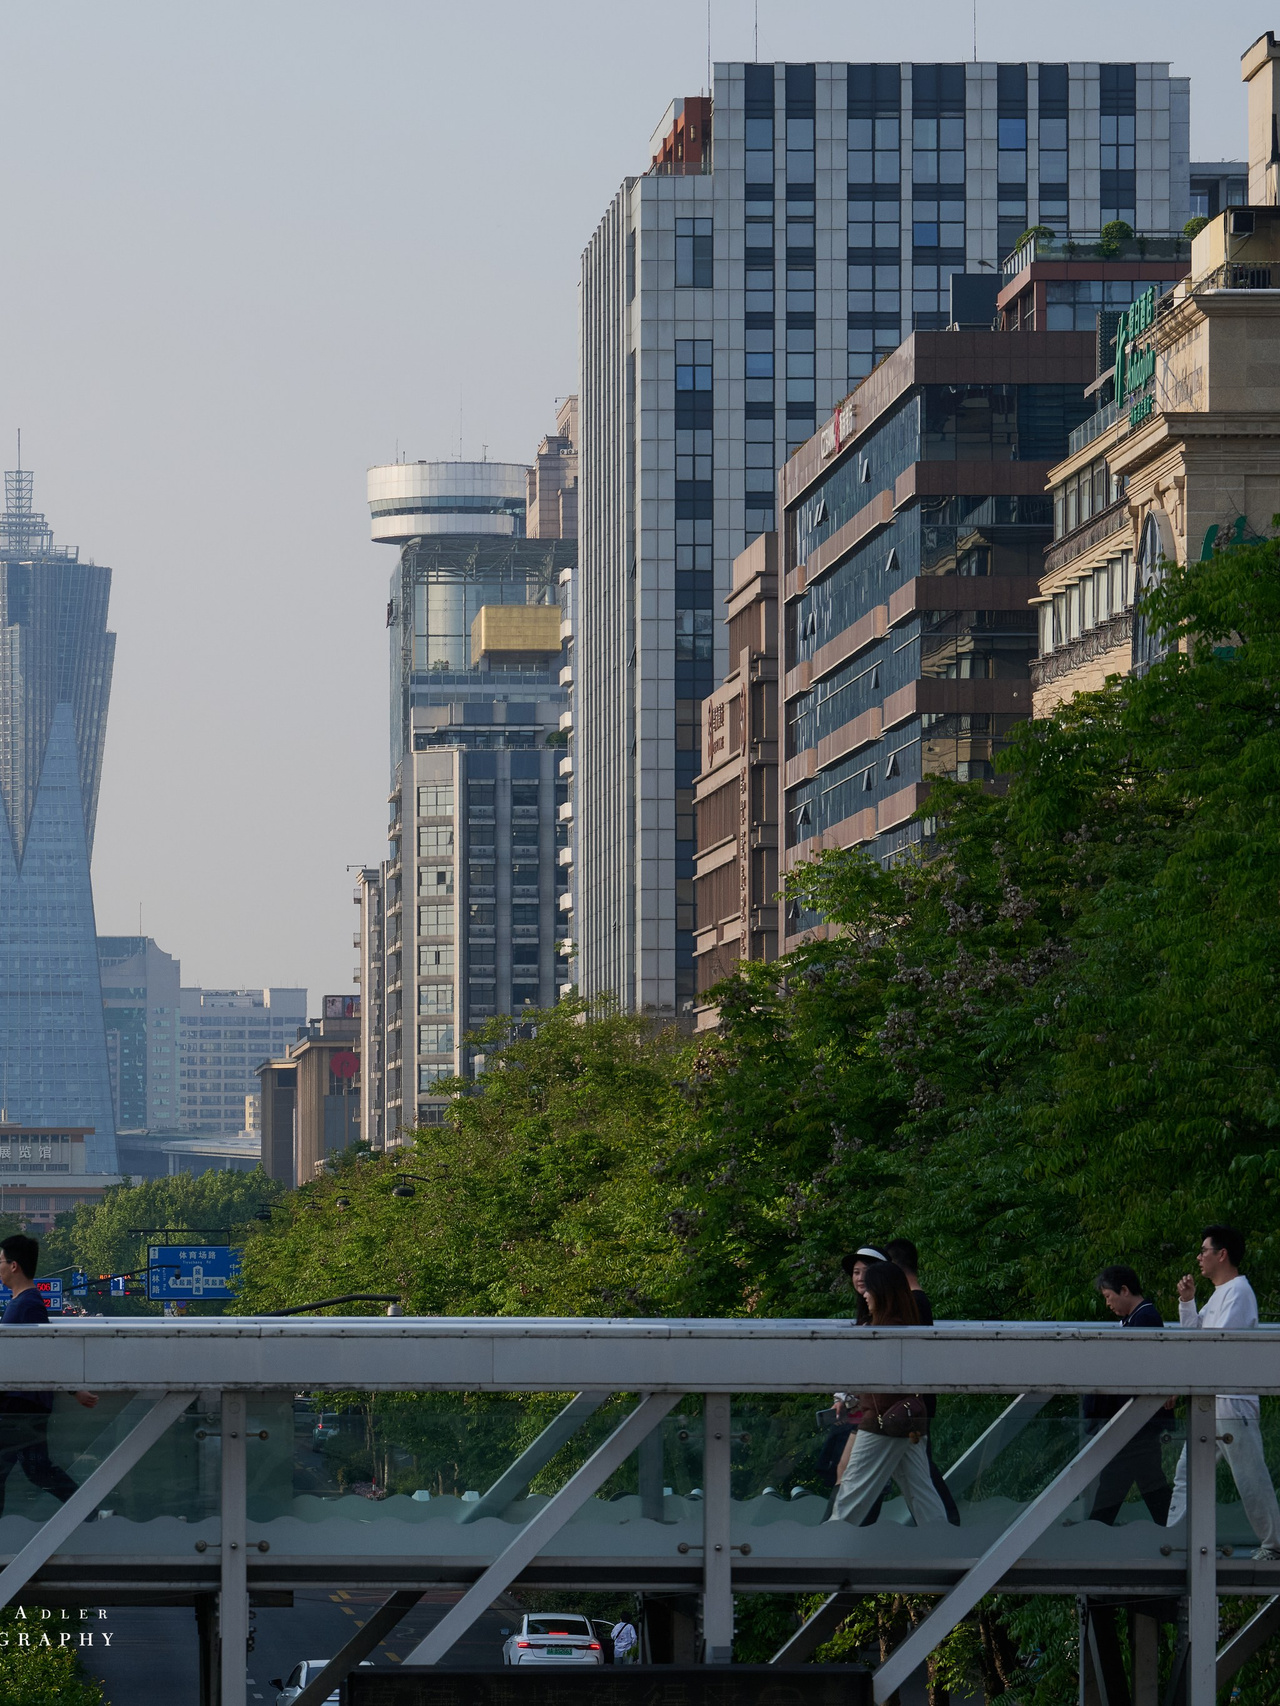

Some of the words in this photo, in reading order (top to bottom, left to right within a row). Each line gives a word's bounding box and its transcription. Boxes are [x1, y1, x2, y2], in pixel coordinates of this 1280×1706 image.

[179, 1251, 216, 1260] 体育场路
[37, 1283, 51, 1291] 506
